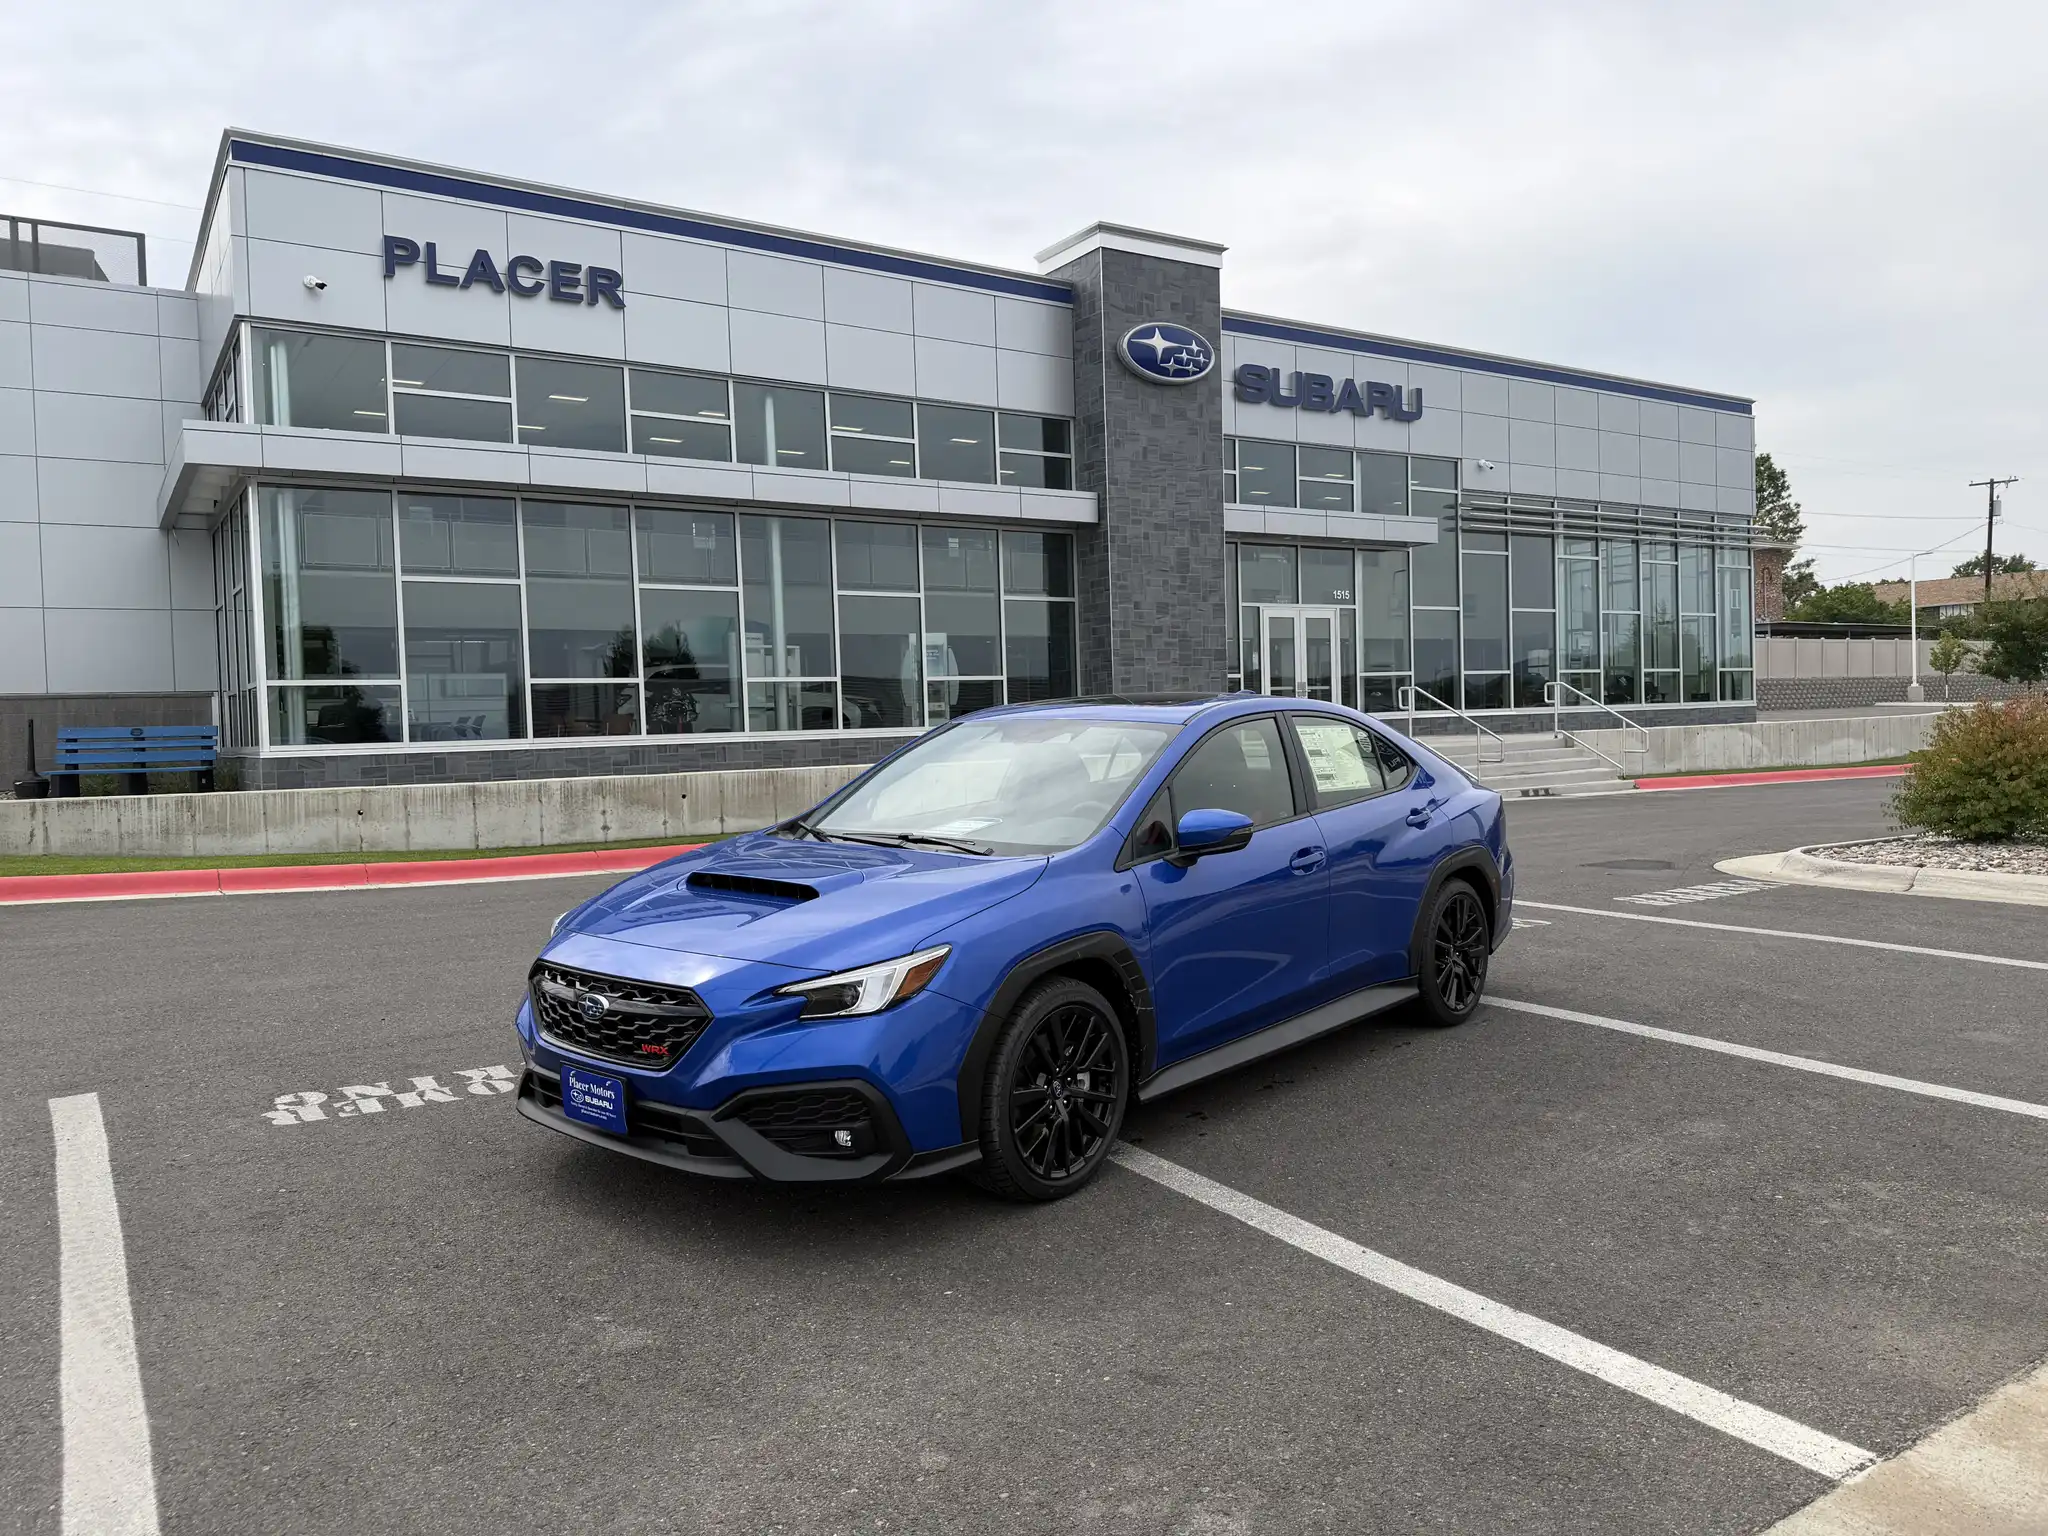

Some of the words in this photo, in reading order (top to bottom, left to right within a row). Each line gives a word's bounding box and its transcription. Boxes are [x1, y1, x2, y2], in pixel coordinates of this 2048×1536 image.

[383, 234, 626, 309] PLACER
[1234, 363, 1423, 422] SUBARU
[1333, 590, 1350, 600] 1515
[641, 1043, 670, 1056] WRX
[569, 1076, 589, 1092] Placer
[590, 1083, 615, 1100] Motors
[584, 1095, 613, 1110] SUBARU
